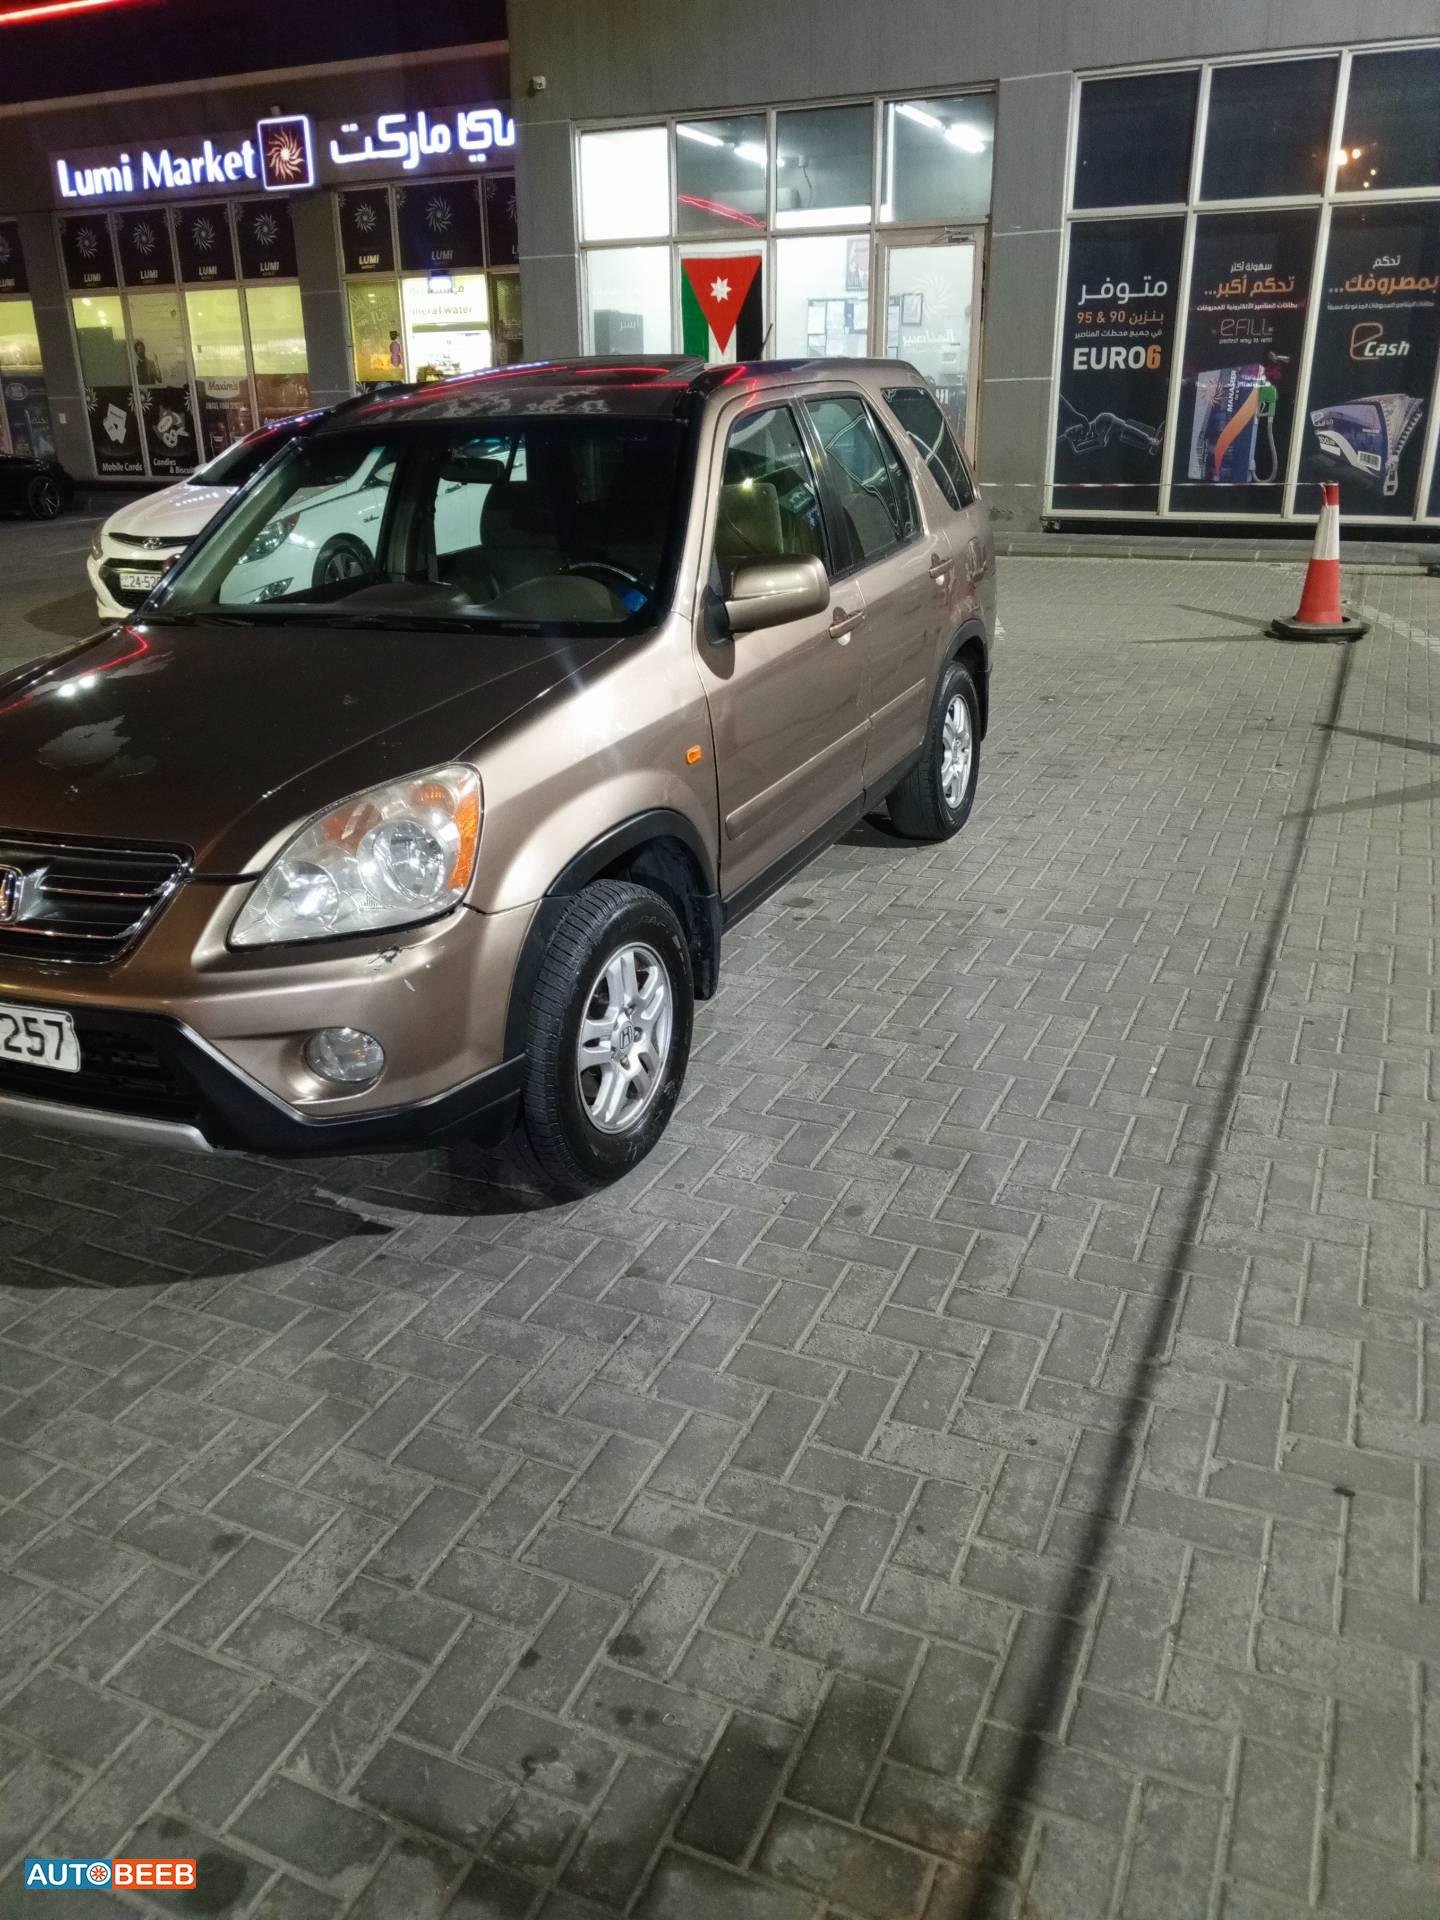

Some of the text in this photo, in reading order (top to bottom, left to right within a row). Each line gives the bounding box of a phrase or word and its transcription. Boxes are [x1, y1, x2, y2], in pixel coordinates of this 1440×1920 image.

[56, 140, 257, 197] Lumi Market
[358, 254, 380, 265] LUMI
[432, 250, 454, 260] LUMI
[198, 265, 218, 276] LUMI
[260, 261, 280, 272] LUMI
[83, 273, 102, 283] LUMI
[140, 269, 159, 280] LUMI
[1249, 276, 1296, 297] تحكم
[444, 304, 473, 316] water
[1077, 311, 1094, 324] 95
[1096, 311, 1105, 323] &
[1110, 310, 1126, 323] 90
[1073, 344, 1162, 370] EURO6
[102, 462, 143, 472] Mobile Cards
